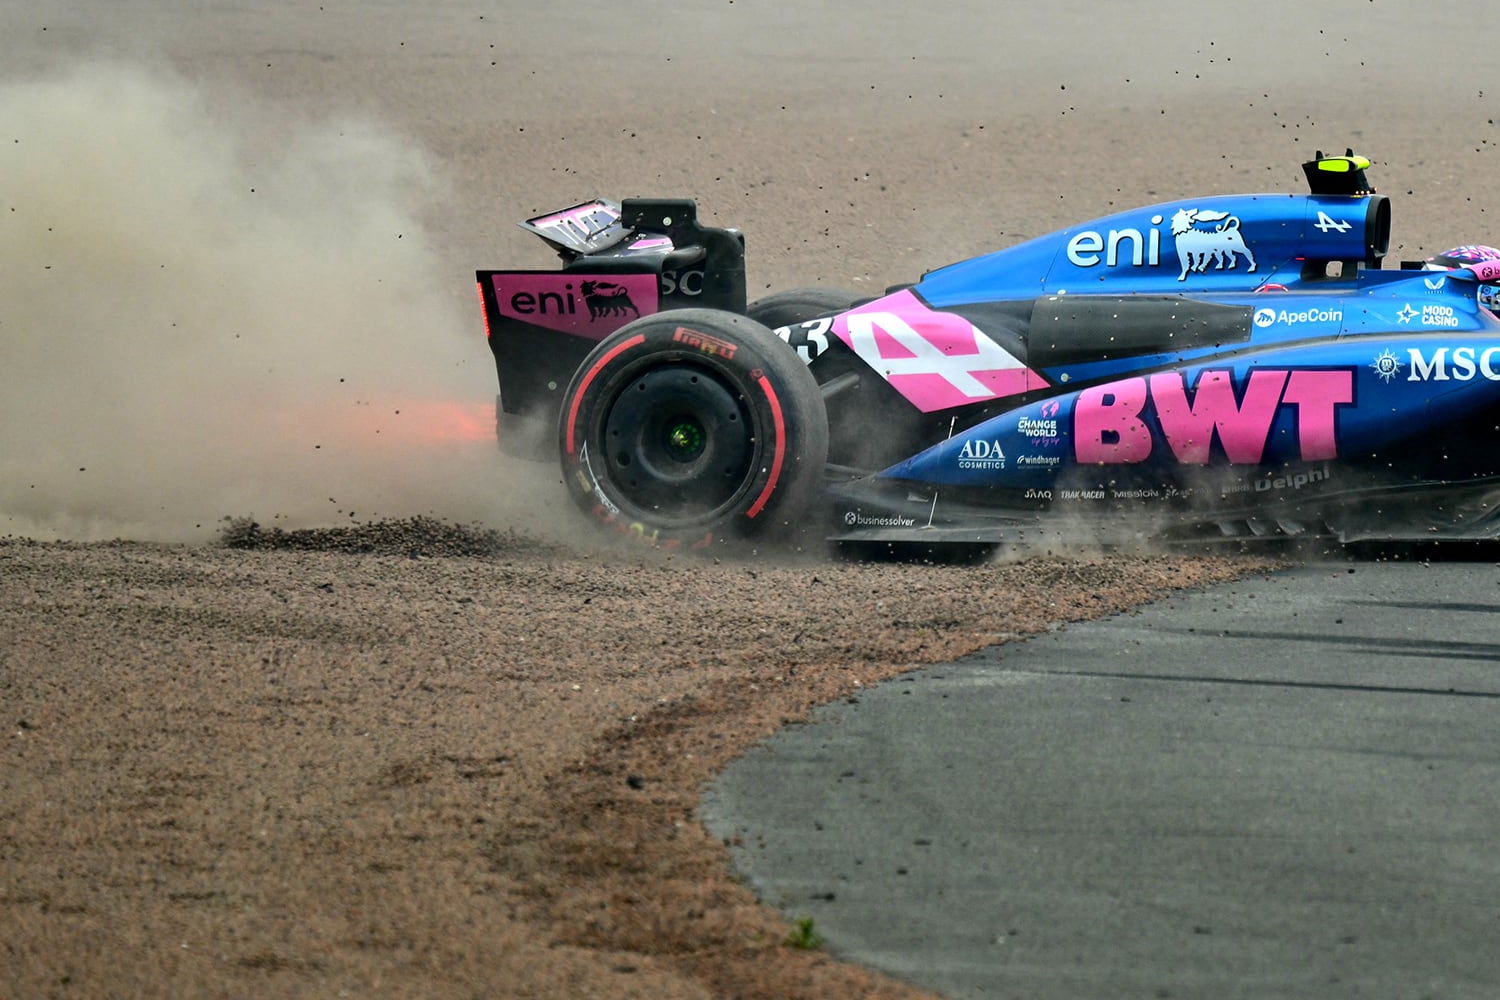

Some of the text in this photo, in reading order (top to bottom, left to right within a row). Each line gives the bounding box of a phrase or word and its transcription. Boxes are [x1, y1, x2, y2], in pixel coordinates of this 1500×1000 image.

[1066, 215, 1164, 267] eni
[661, 270, 705, 296] SC
[511, 283, 576, 314] eni
[1277, 308, 1343, 326] ApeCoin
[1422, 305, 1453, 316] MODO
[1421, 314, 1459, 327] CASINO
[673, 326, 738, 360] PIRELLI
[1018, 420, 1057, 429] CHANGE
[1074, 371, 1352, 464] BWT
[1025, 429, 1057, 437] WORLD
[958, 440, 1005, 458] ADA
[958, 461, 1005, 469] COSMETICS
[1025, 454, 1060, 466] windhager
[1254, 464, 1331, 492] Delphi
[1113, 489, 1159, 498] MISSION
[857, 514, 915, 527] businessolver
